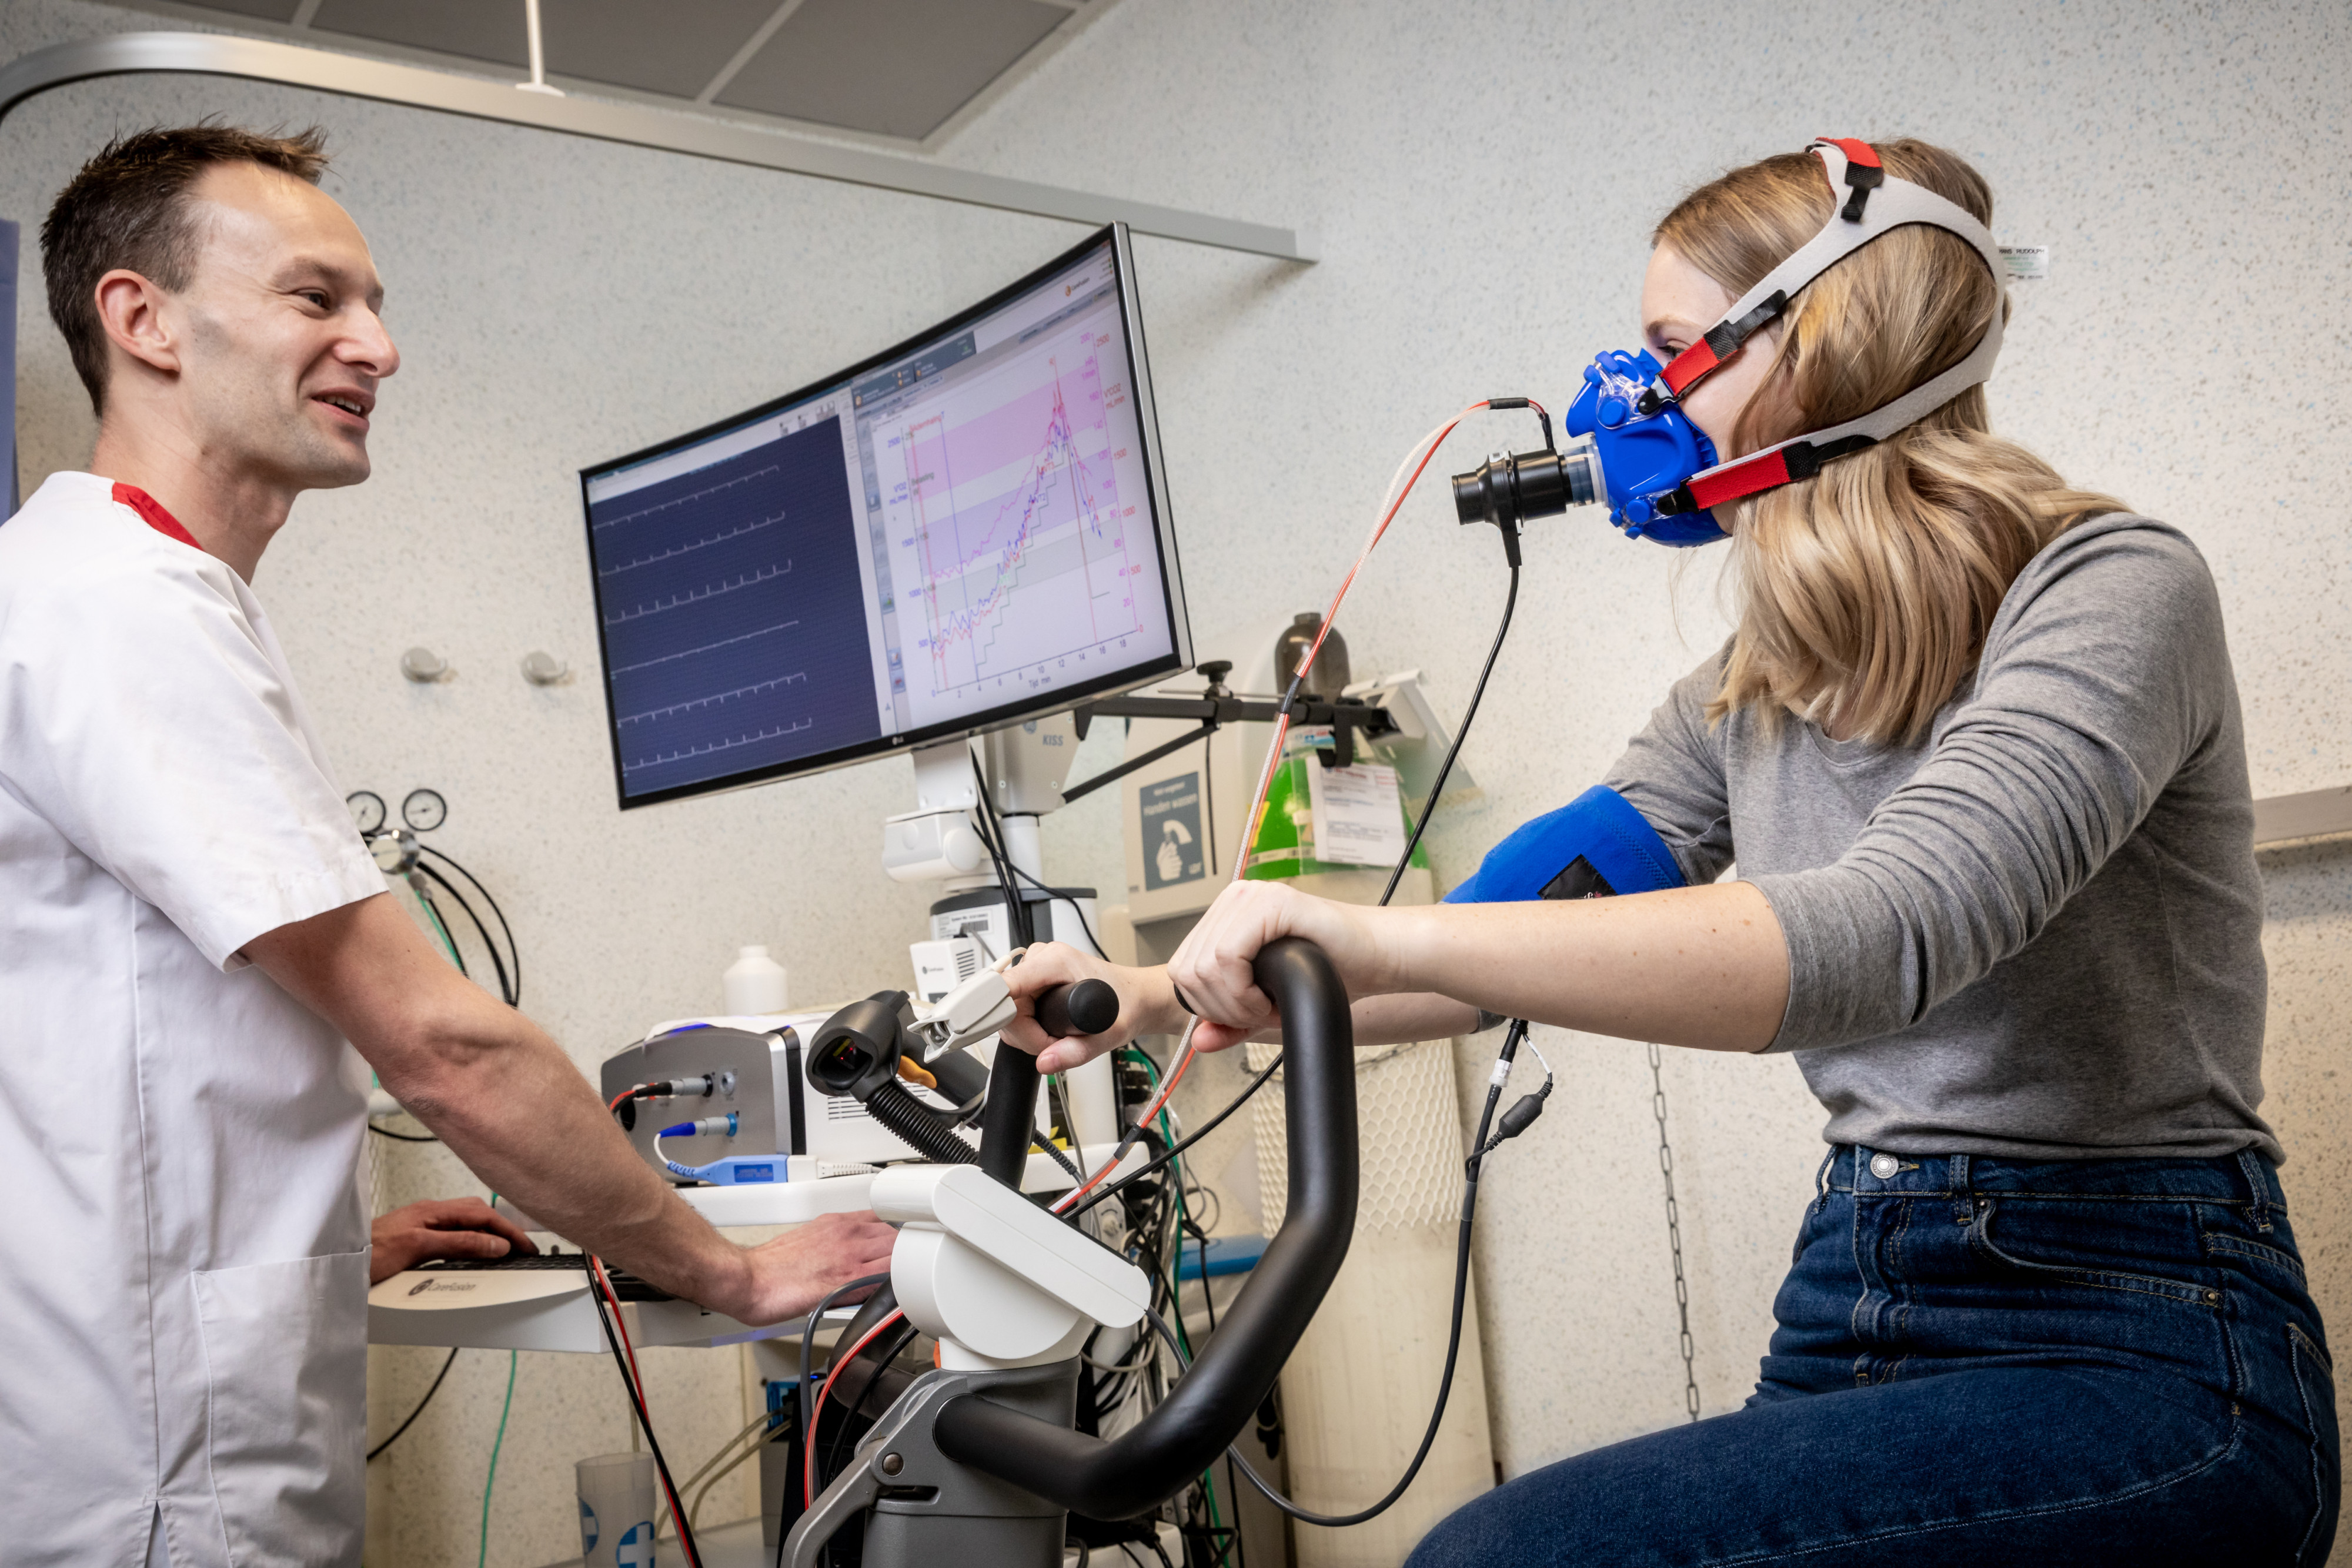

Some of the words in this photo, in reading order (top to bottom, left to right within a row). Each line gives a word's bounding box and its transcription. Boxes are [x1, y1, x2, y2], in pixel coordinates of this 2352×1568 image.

[1080, 332, 1090, 344] 200
[1097, 333, 1110, 347] 2500
[1089, 390, 1100, 401] 160
[887, 436, 901, 448] 2500
[1098, 449, 1108, 461] 120
[1114, 447, 1127, 460] 1500
[1102, 479, 1112, 490] 100
[1122, 506, 1136, 517] 1000
[902, 537, 915, 548] 1500
[1118, 567, 1125, 577] 40
[1131, 564, 1142, 576] 500
[908, 589, 922, 599] 1000
[1123, 597, 1131, 607] 20
[1139, 624, 1144, 633] 0
[918, 638, 928, 648] 500
[1038, 666, 1045, 674] 10
[1058, 659, 1065, 668] 12
[1099, 646, 1106, 654] 16
[1120, 639, 1127, 648] 18
[1028, 678, 1038, 689] Tijd
[1041, 676, 1051, 684] min
[1043, 735, 1063, 747] KISS
[427, 1282, 476, 1291] CareFusion
